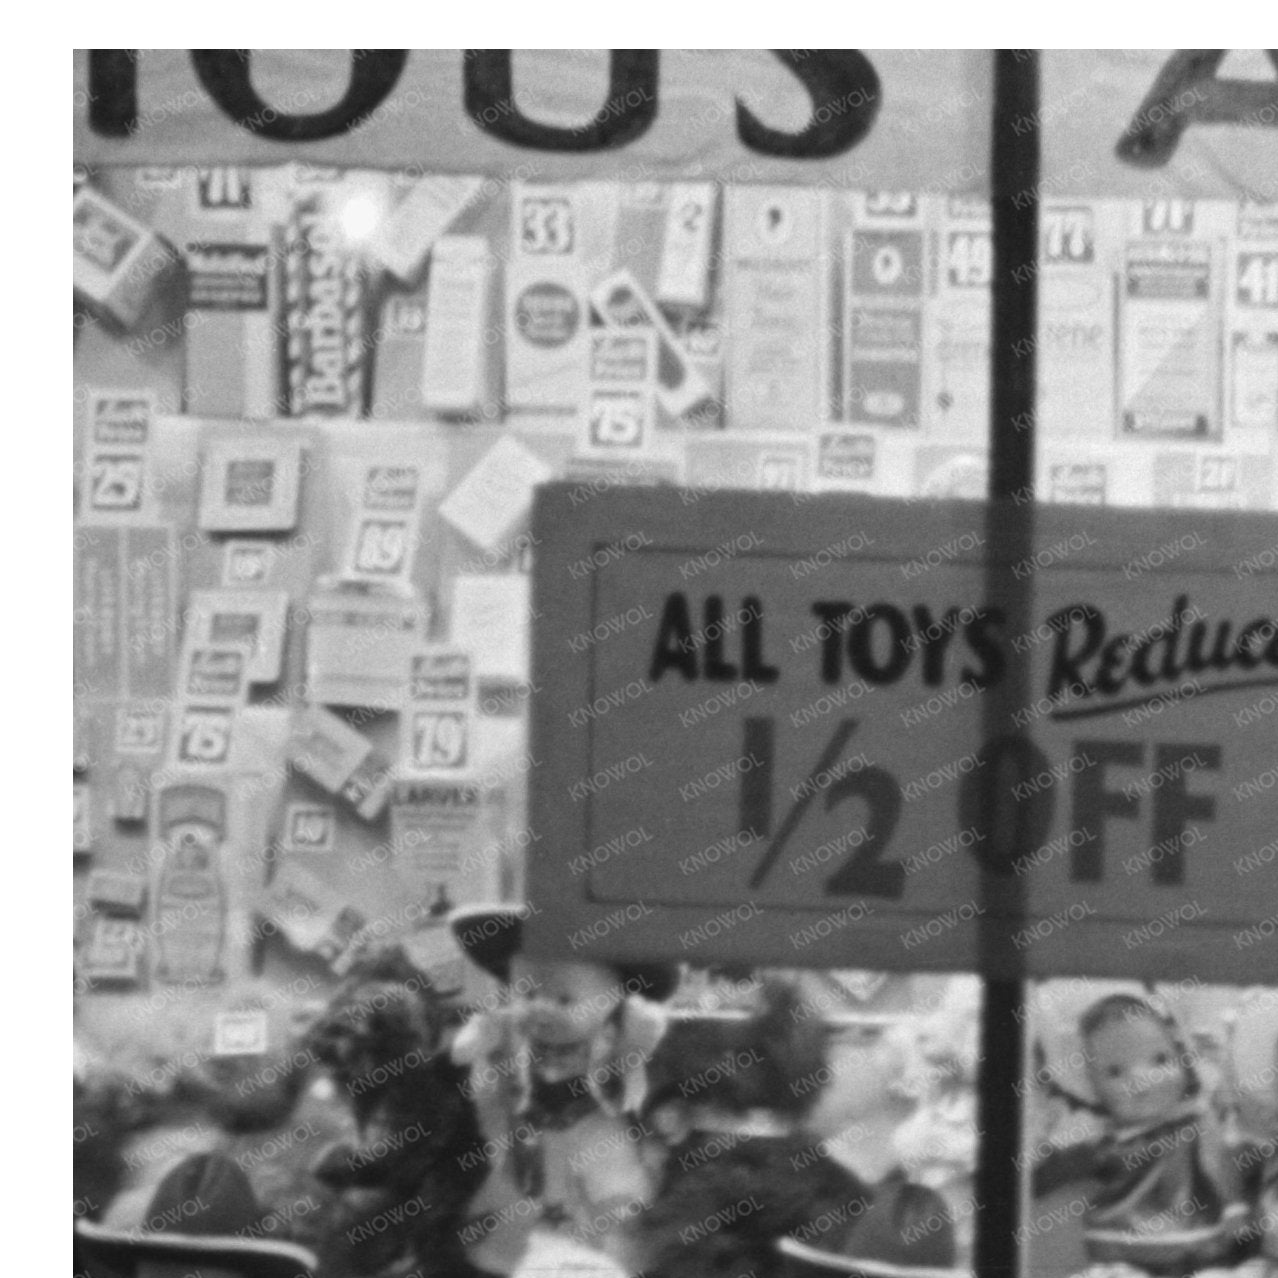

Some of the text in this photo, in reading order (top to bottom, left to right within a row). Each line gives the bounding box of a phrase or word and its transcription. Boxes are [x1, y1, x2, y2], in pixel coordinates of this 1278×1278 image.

[648, 591, 780, 684] ALL
[811, 597, 1008, 688] TOYS
[957, 733, 1221, 886] OFF
